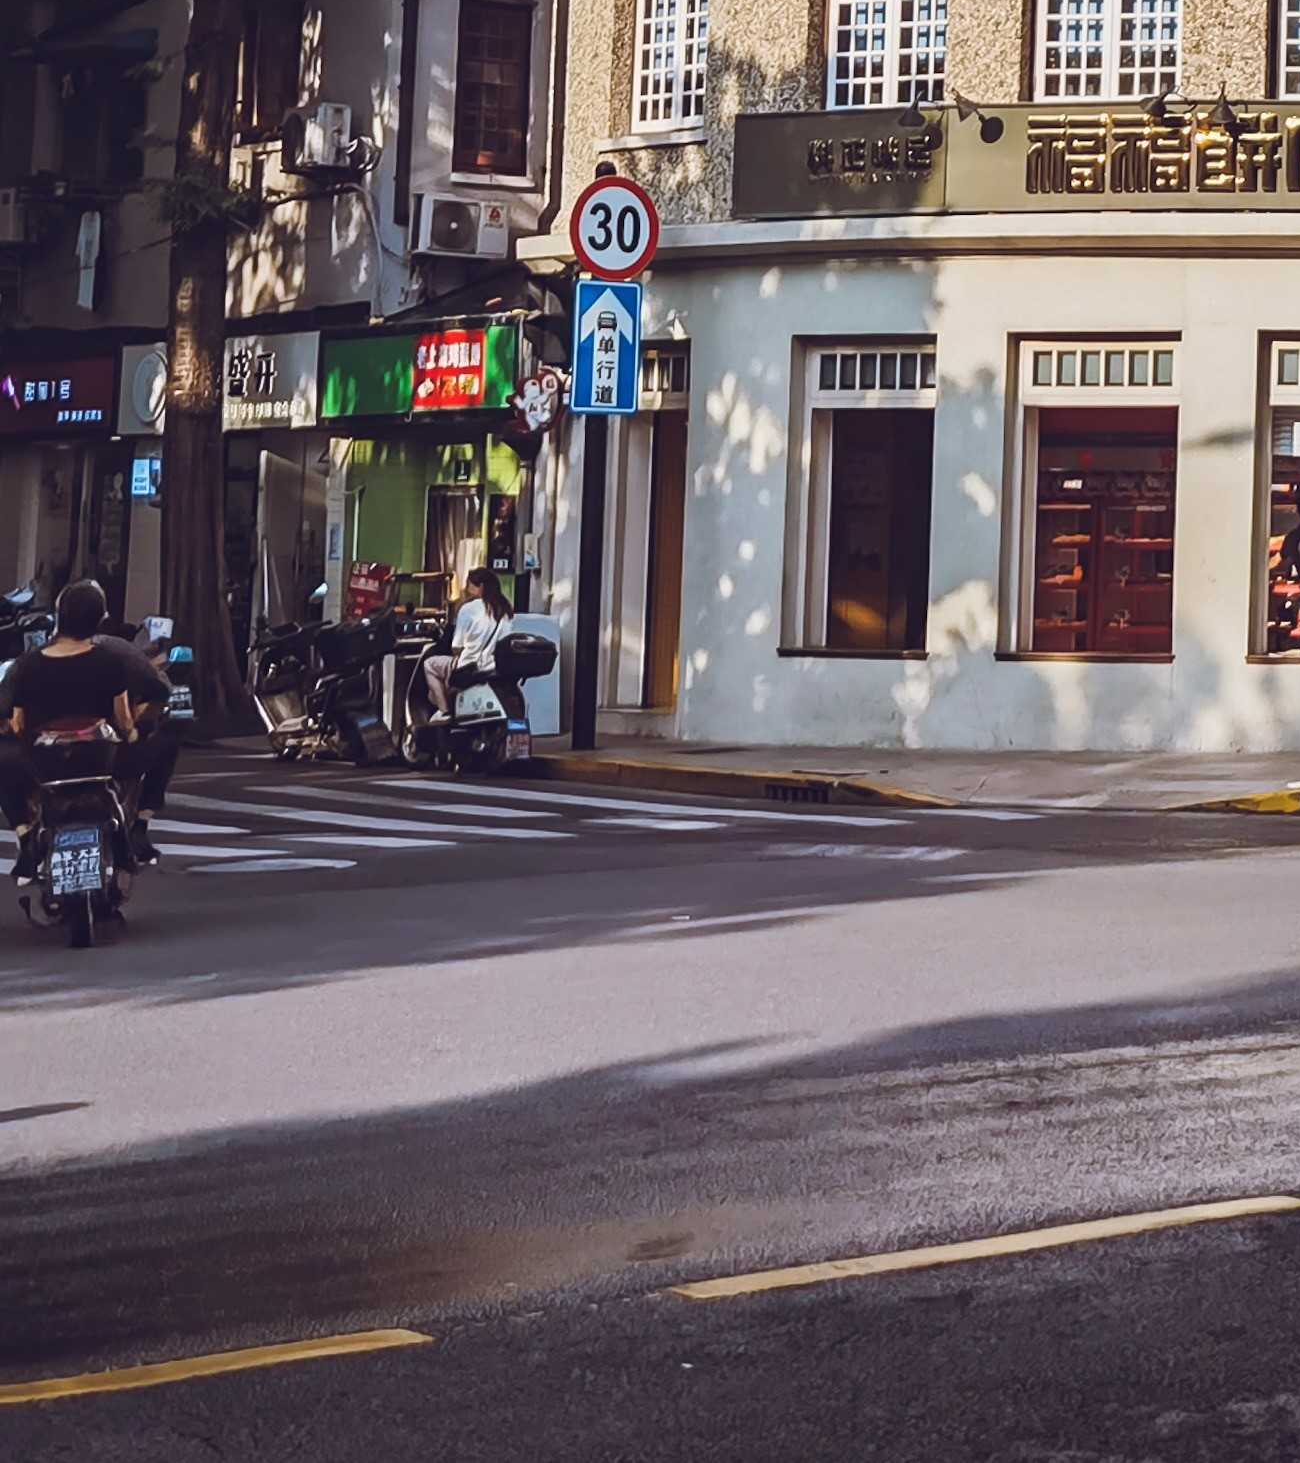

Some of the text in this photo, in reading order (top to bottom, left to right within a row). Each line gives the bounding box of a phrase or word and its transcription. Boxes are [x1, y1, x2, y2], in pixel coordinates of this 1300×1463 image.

[588, 202, 641, 253] 30
[594, 336, 617, 405] 单行道
